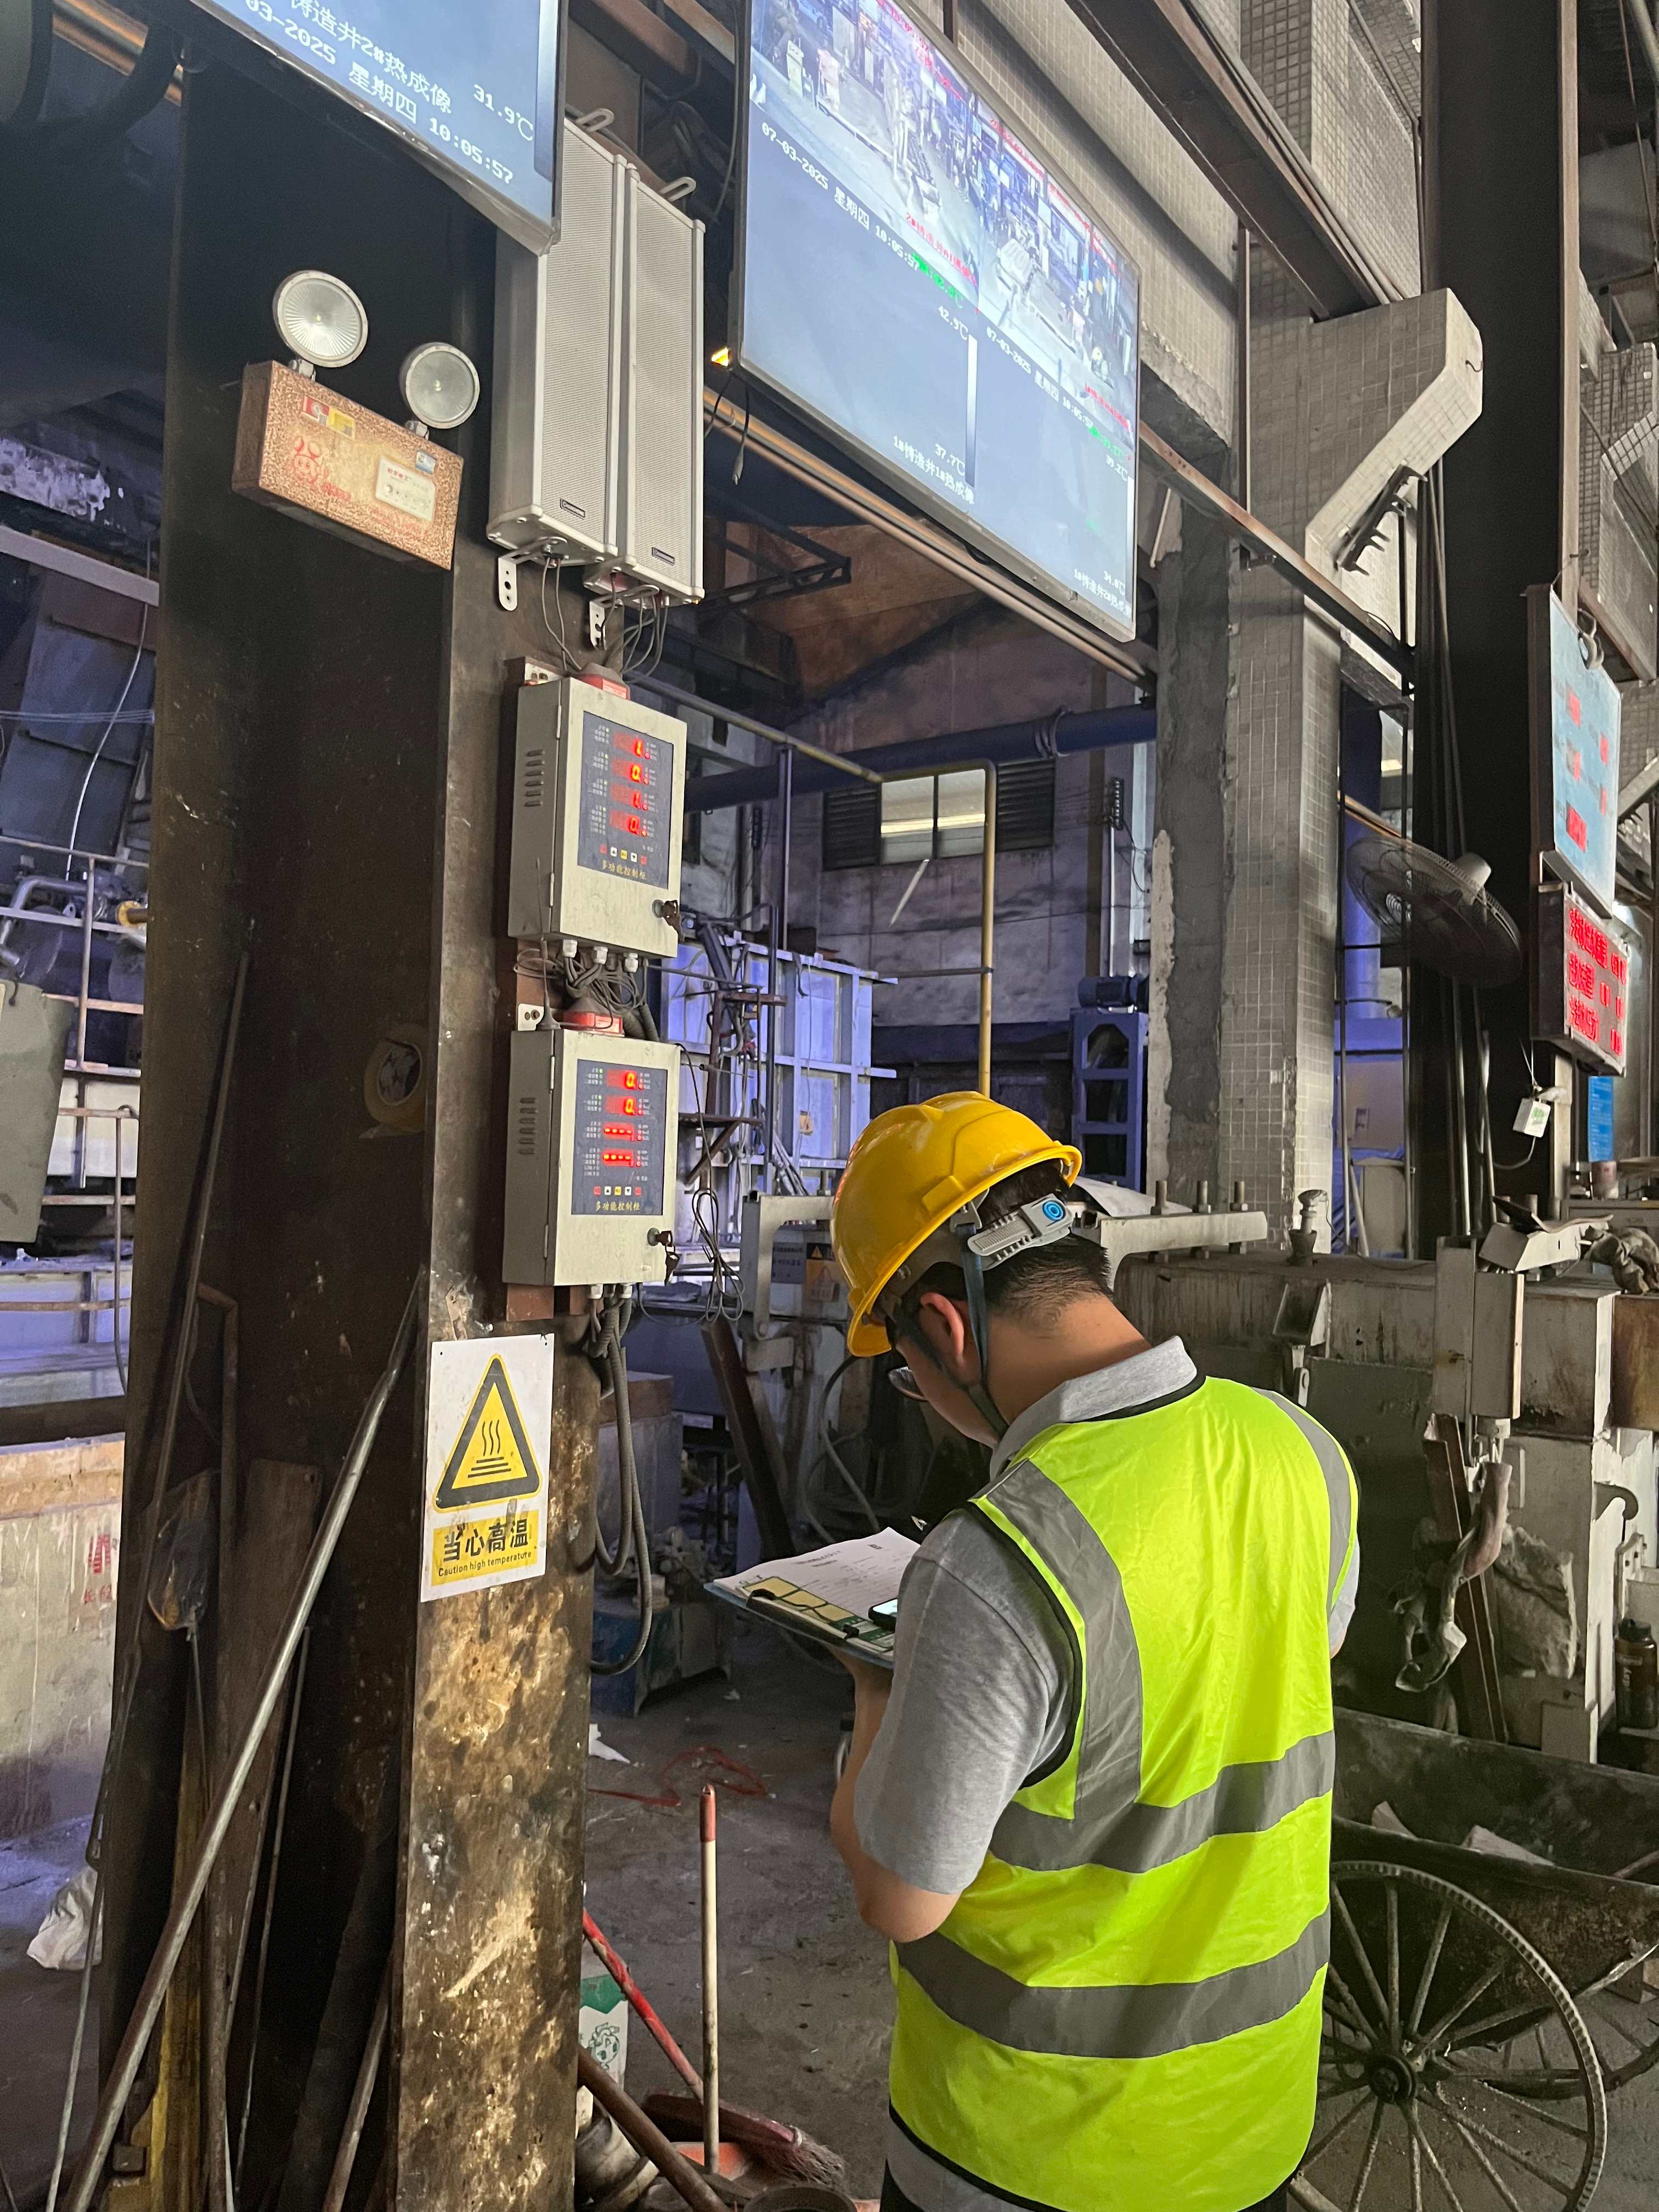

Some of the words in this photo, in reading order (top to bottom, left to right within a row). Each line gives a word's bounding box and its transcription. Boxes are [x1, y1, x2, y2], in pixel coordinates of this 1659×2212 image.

[348, 61, 417, 124] 星期四
[429, 117, 514, 185] 10:05:57
[473, 84, 534, 142] 31.9℃
[762, 123, 828, 189] 07-03-2025
[834, 187, 870, 229] 星期四
[875, 225, 920, 271] 10:05:57
[938, 306, 969, 341] 42.9℃
[986, 326, 1031, 374] 07-03-2025
[934, 443, 965, 476] 37.7℃
[596, 1200, 641, 1211] 多功能控制柜
[443, 1518, 528, 1562] 当心高温
[438, 1564, 469, 1577] Caution
[470, 1559, 487, 1572] high
[488, 1550, 532, 1568] temperature
